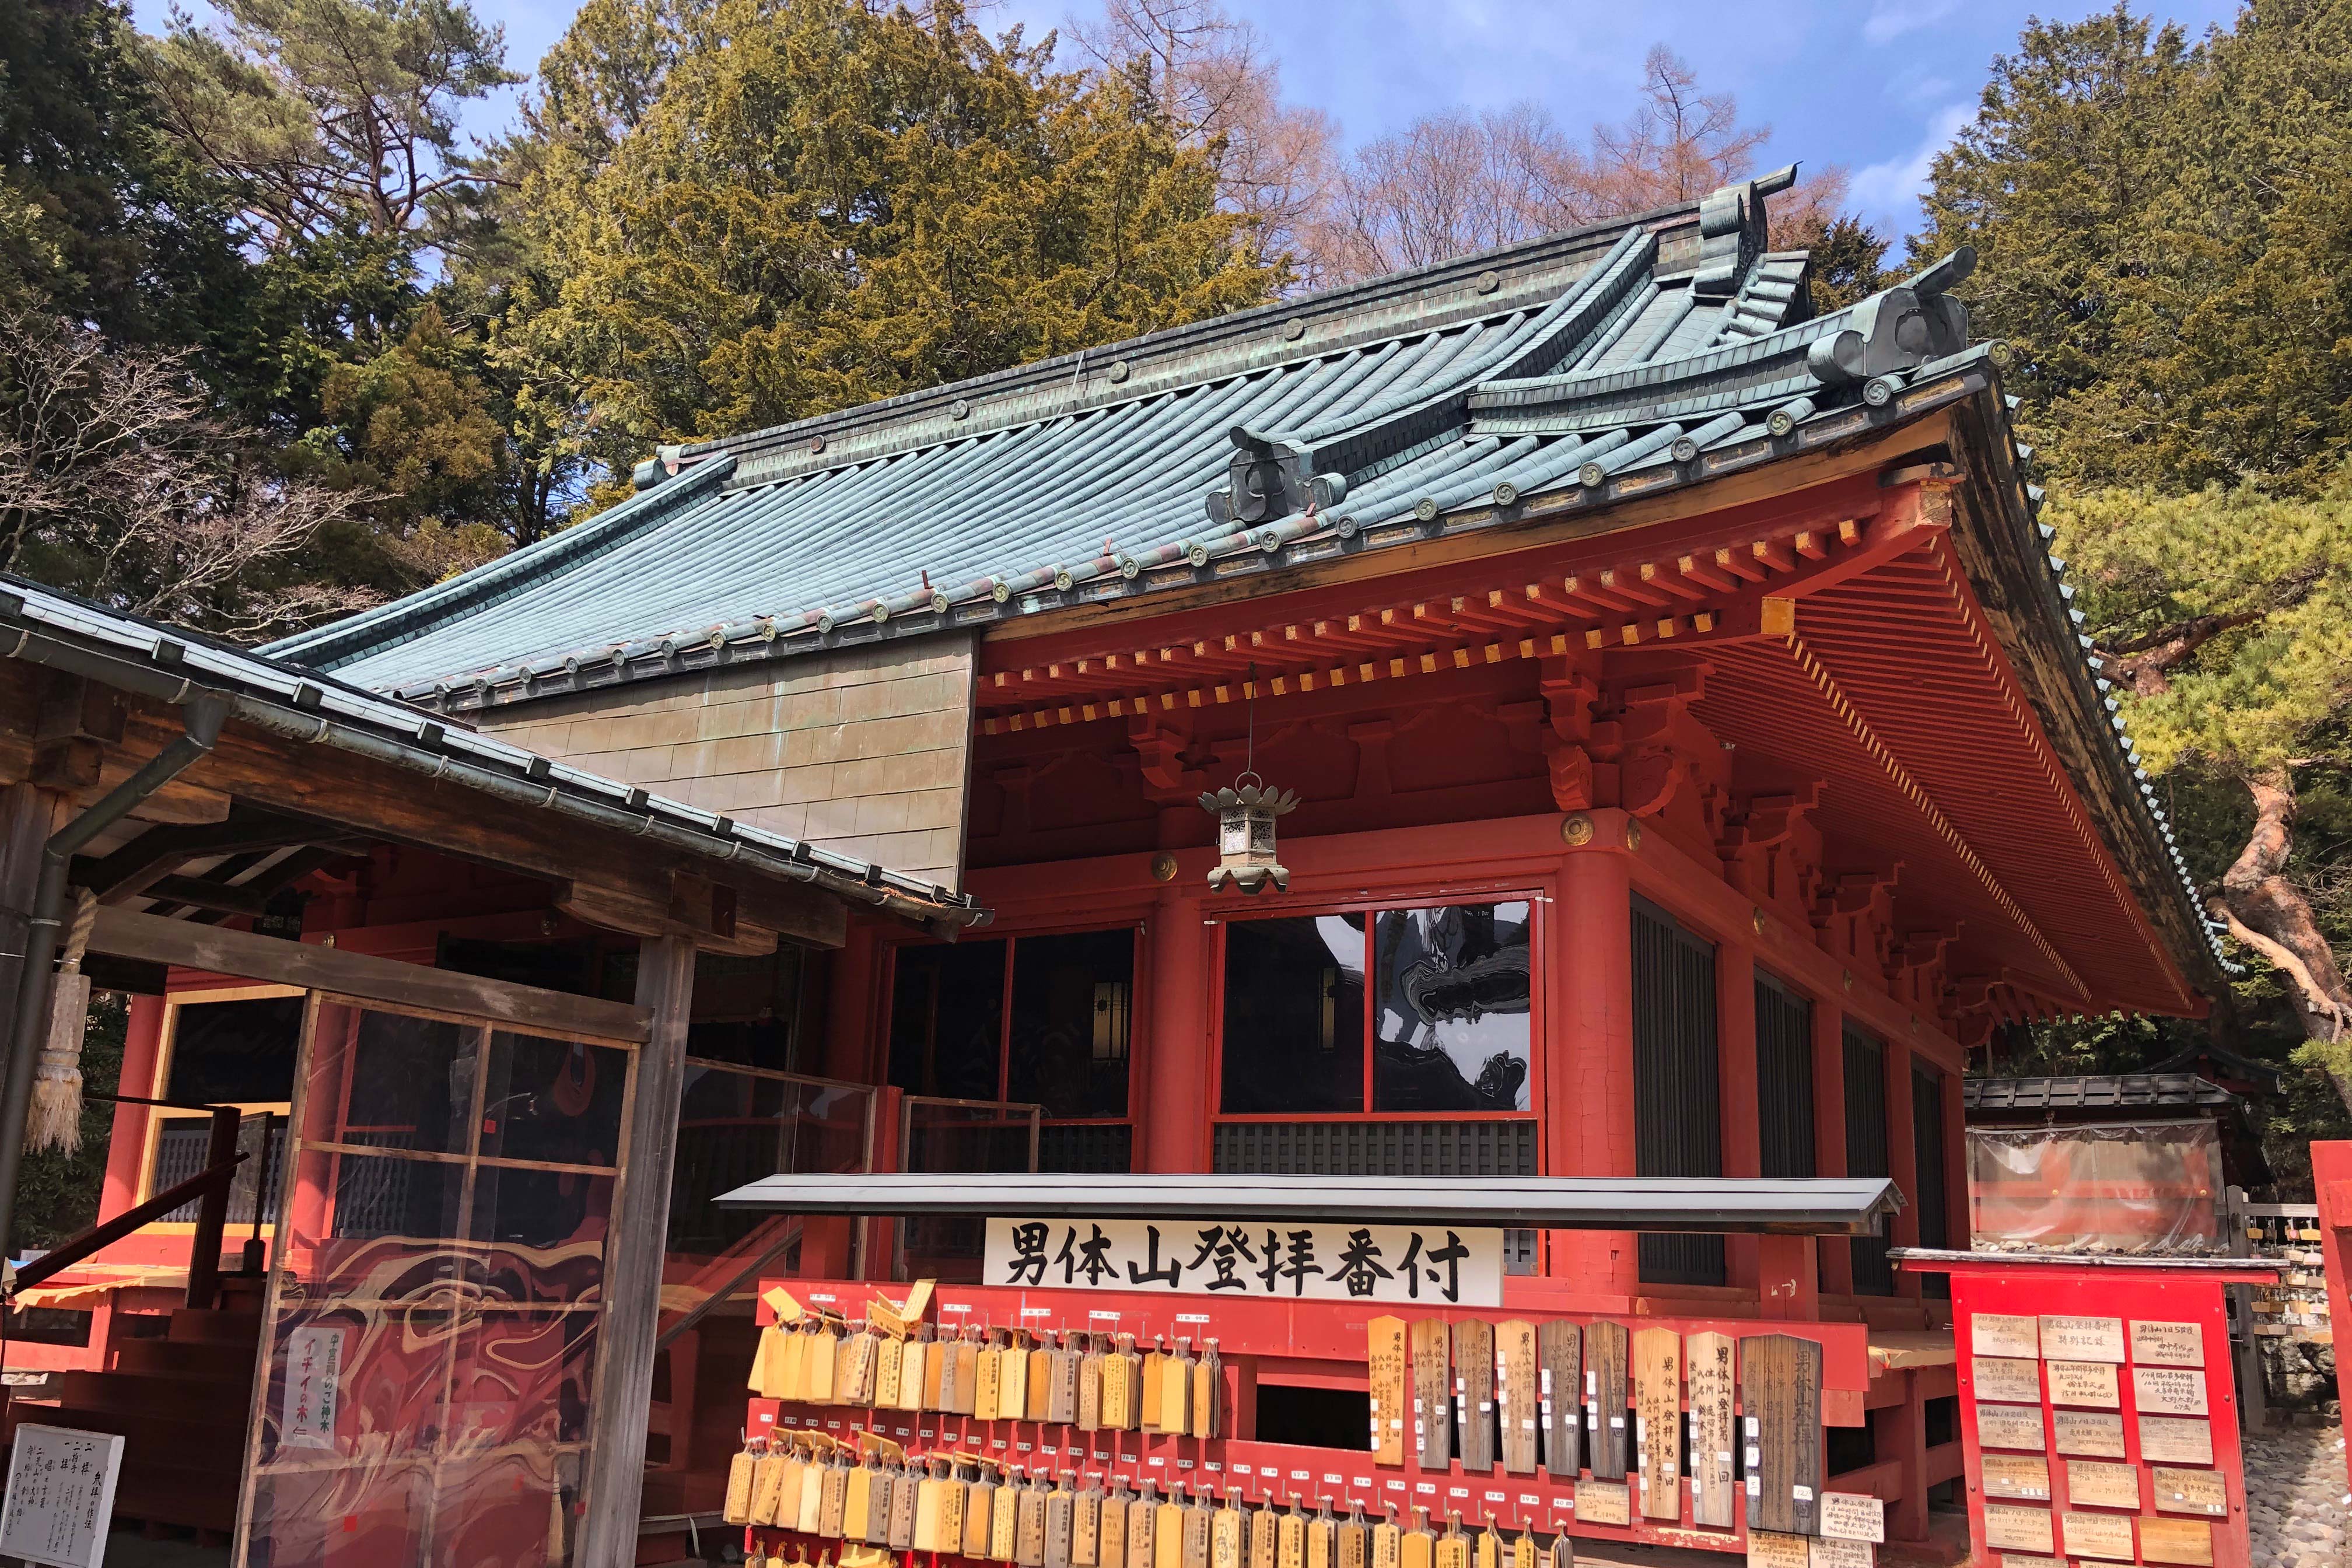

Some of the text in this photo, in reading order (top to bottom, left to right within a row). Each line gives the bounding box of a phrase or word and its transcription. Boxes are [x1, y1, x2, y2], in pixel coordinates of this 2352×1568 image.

[1006, 1221, 1470, 1302] 男体山登拝番付
[296, 1338, 316, 1423] イチイの木
[1718, 1471, 1730, 1483] 回
